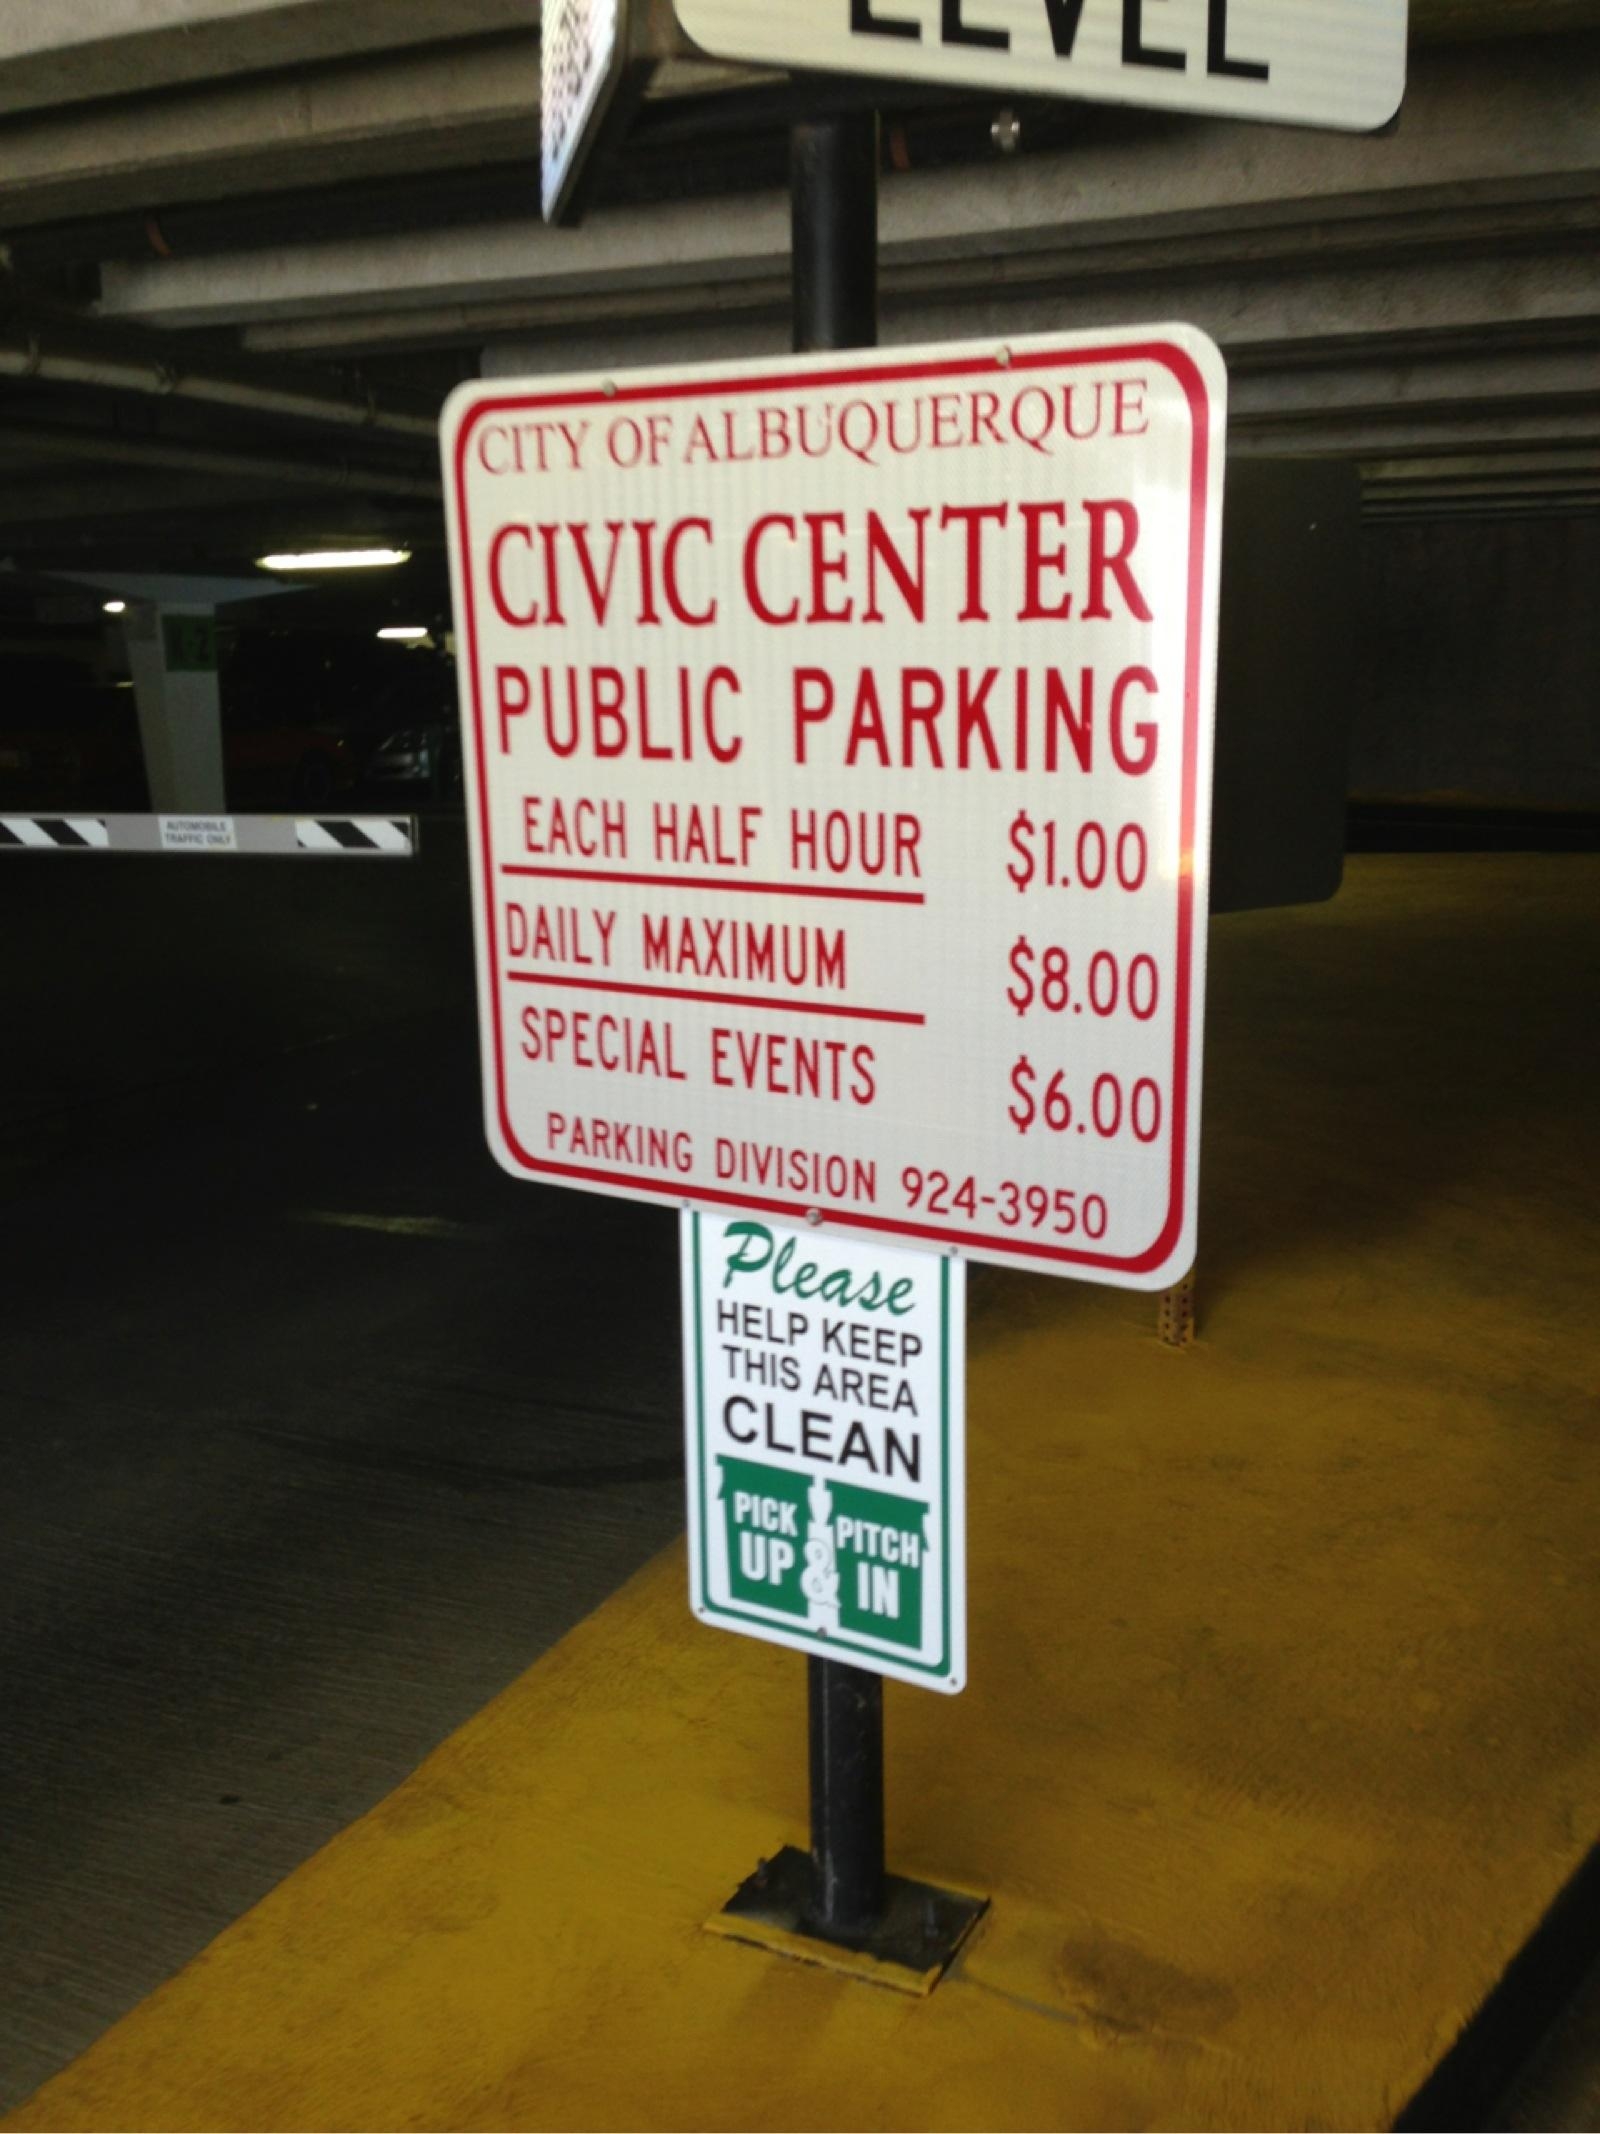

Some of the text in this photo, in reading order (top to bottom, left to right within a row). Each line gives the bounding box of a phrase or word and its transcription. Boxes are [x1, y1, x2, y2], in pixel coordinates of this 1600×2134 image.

[477, 379, 1149, 475] CITY OF ALBUQUERQUE
[486, 497, 1153, 631] CIVIC CENTER
[493, 663, 1159, 779] PUBLIC PARKING
[522, 795, 1149, 894] EACH HALF HOUR $1.00
[504, 901, 1160, 1022] DAILY MAXIMUM $8.00
[521, 1005, 1163, 1145] SPECIAL EVENTS $6.00
[547, 1111, 1109, 1241] PARKING DIVISION 924-3950
[722, 1220, 917, 1317] Please
[716, 1298, 923, 1368] HELP KEEP
[721, 1343, 920, 1418] THIS AREA
[723, 1395, 921, 1483] CLEAN
[733, 1490, 799, 1537] PICK
[739, 1530, 796, 1586] UP
[836, 1515, 921, 1569] PITCH
[801, 1537, 840, 1608] &
[856, 1561, 900, 1619] IN
